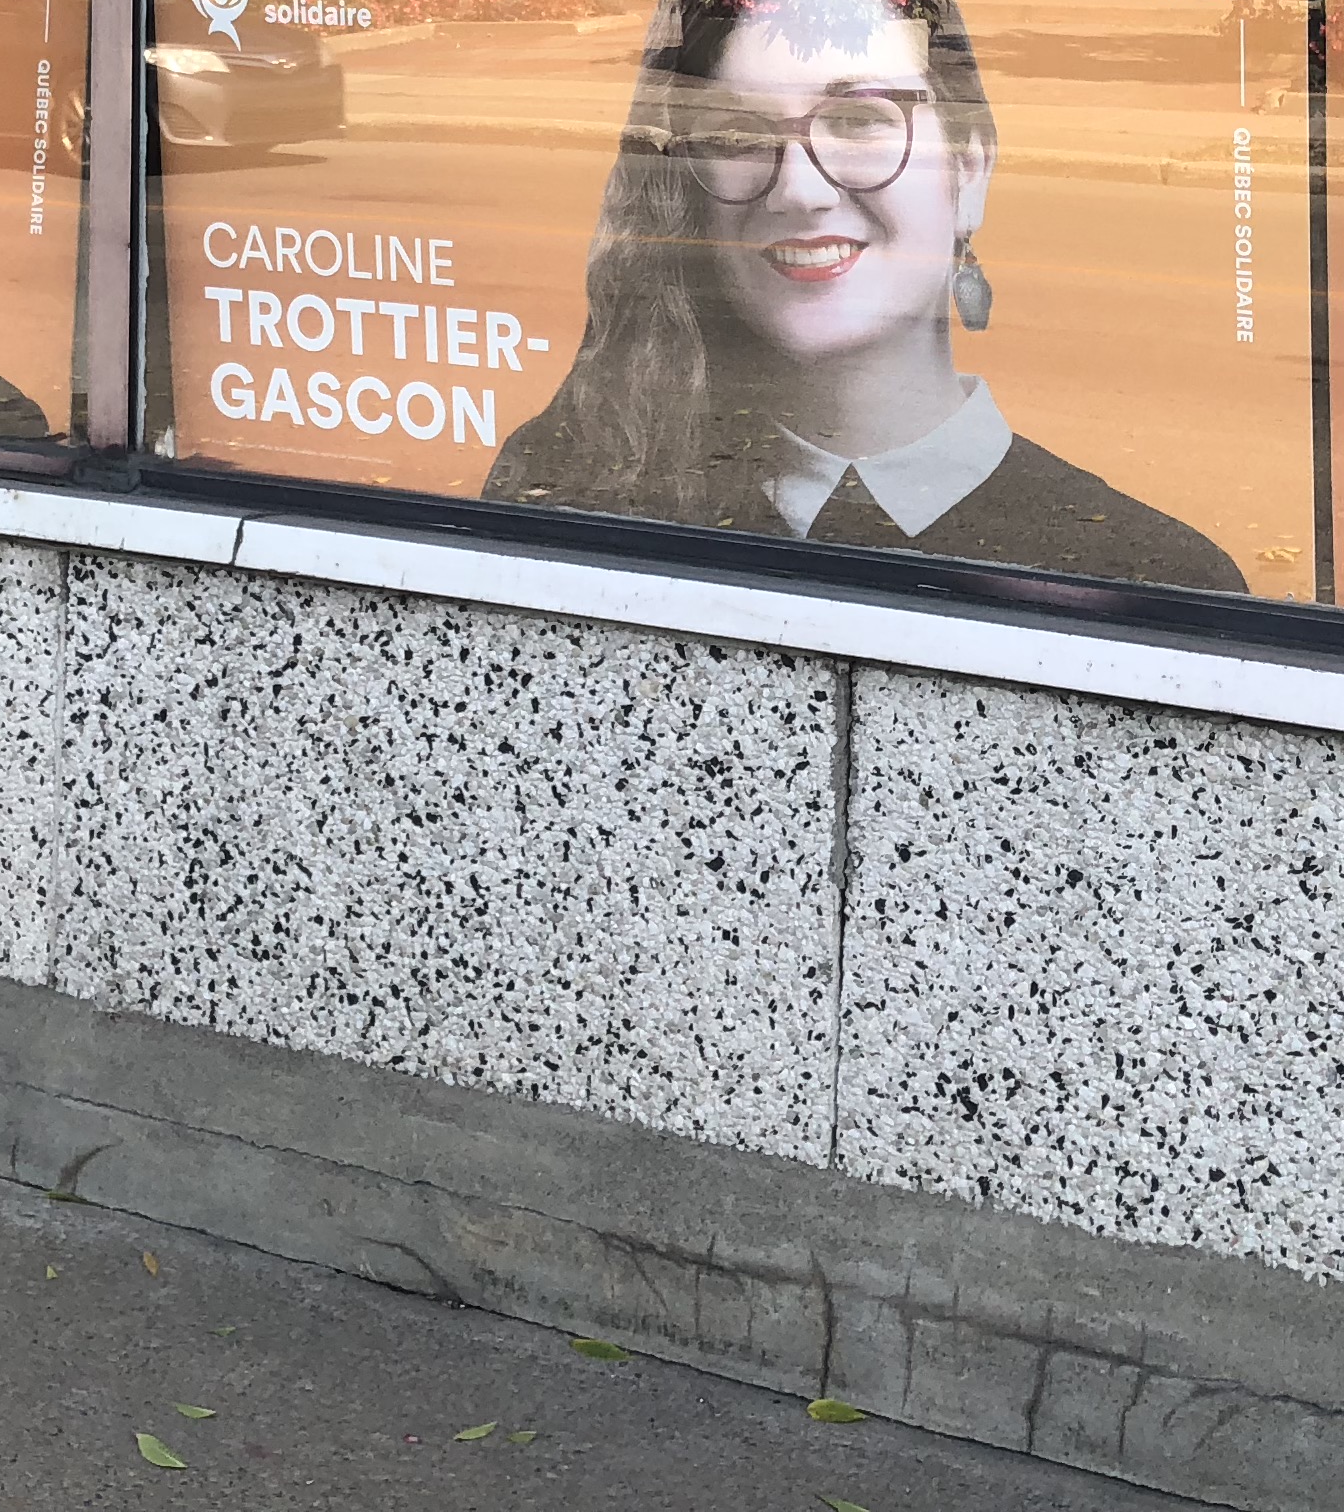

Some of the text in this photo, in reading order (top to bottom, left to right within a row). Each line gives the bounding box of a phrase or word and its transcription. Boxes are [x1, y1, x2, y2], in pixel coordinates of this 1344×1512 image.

[29, 59, 51, 235] QUÉBEC SOLIDAIRE
[203, 222, 455, 287] CAROLINE
[1233, 127, 1255, 343] QUÉBEC SOLIDAIRE
[205, 286, 549, 372] TROTTIER-
[210, 362, 496, 447] GASCON
